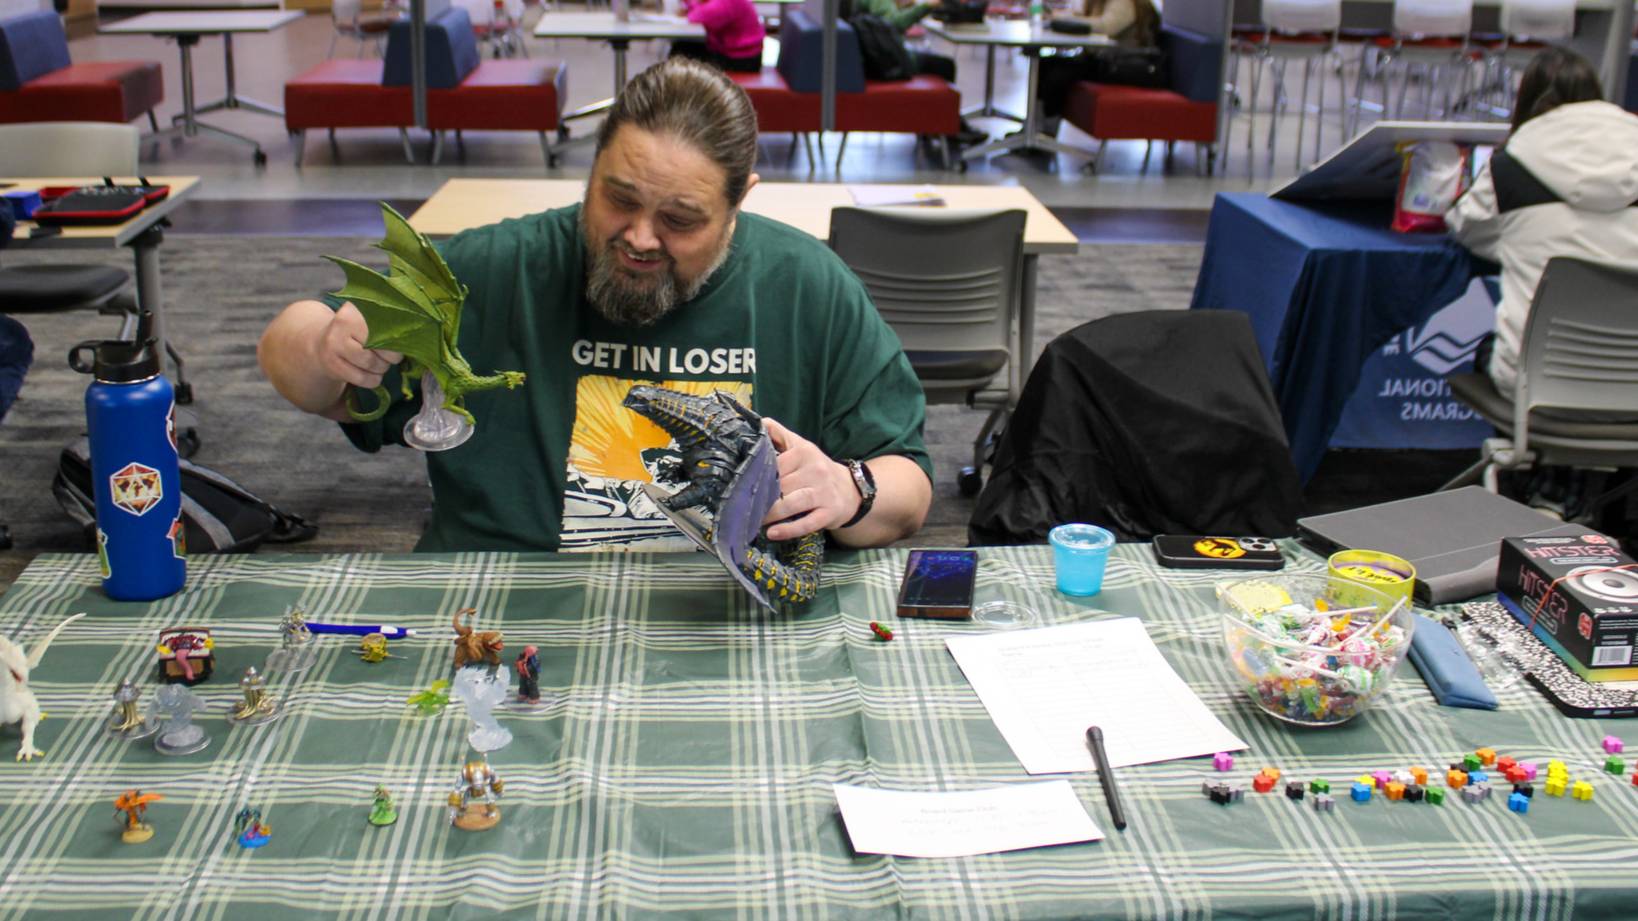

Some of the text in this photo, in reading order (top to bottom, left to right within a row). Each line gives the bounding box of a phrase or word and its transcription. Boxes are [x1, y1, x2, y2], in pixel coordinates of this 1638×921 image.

[571, 339, 757, 375] GET IN LOSER
[1523, 545, 1620, 559] HITSTER
[1518, 564, 1568, 625] HITSER
